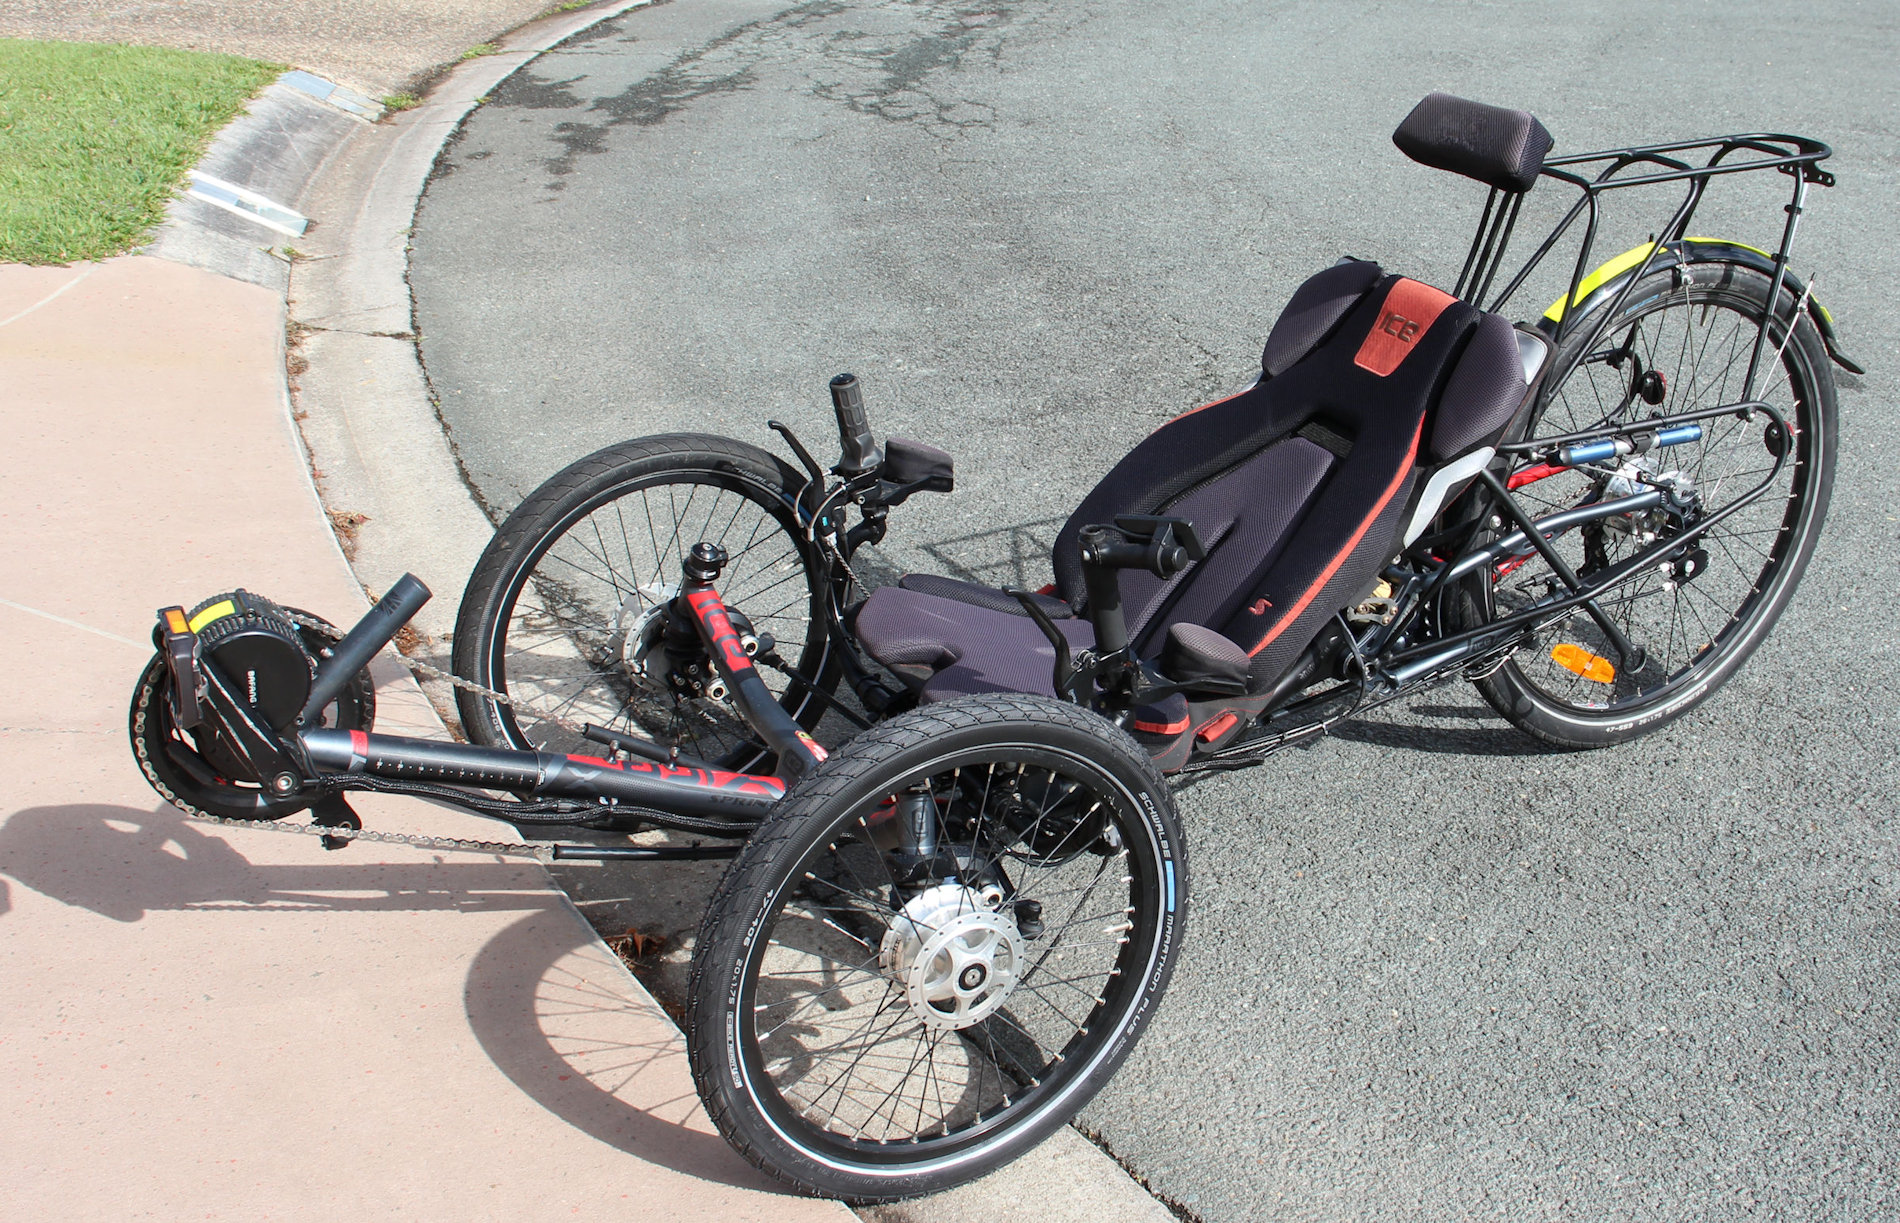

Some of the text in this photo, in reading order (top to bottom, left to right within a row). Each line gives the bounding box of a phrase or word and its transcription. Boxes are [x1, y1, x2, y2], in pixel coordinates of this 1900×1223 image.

[1379, 311, 1419, 342] ICE
[247, 670, 258, 703] BAFANG
[485, 696, 502, 732] 7-406
[743, 889, 774, 947] 47-406
[1126, 791, 1174, 1036] SCHWALBE MARATHON PLUS
[728, 958, 743, 1005] 20x1.75
